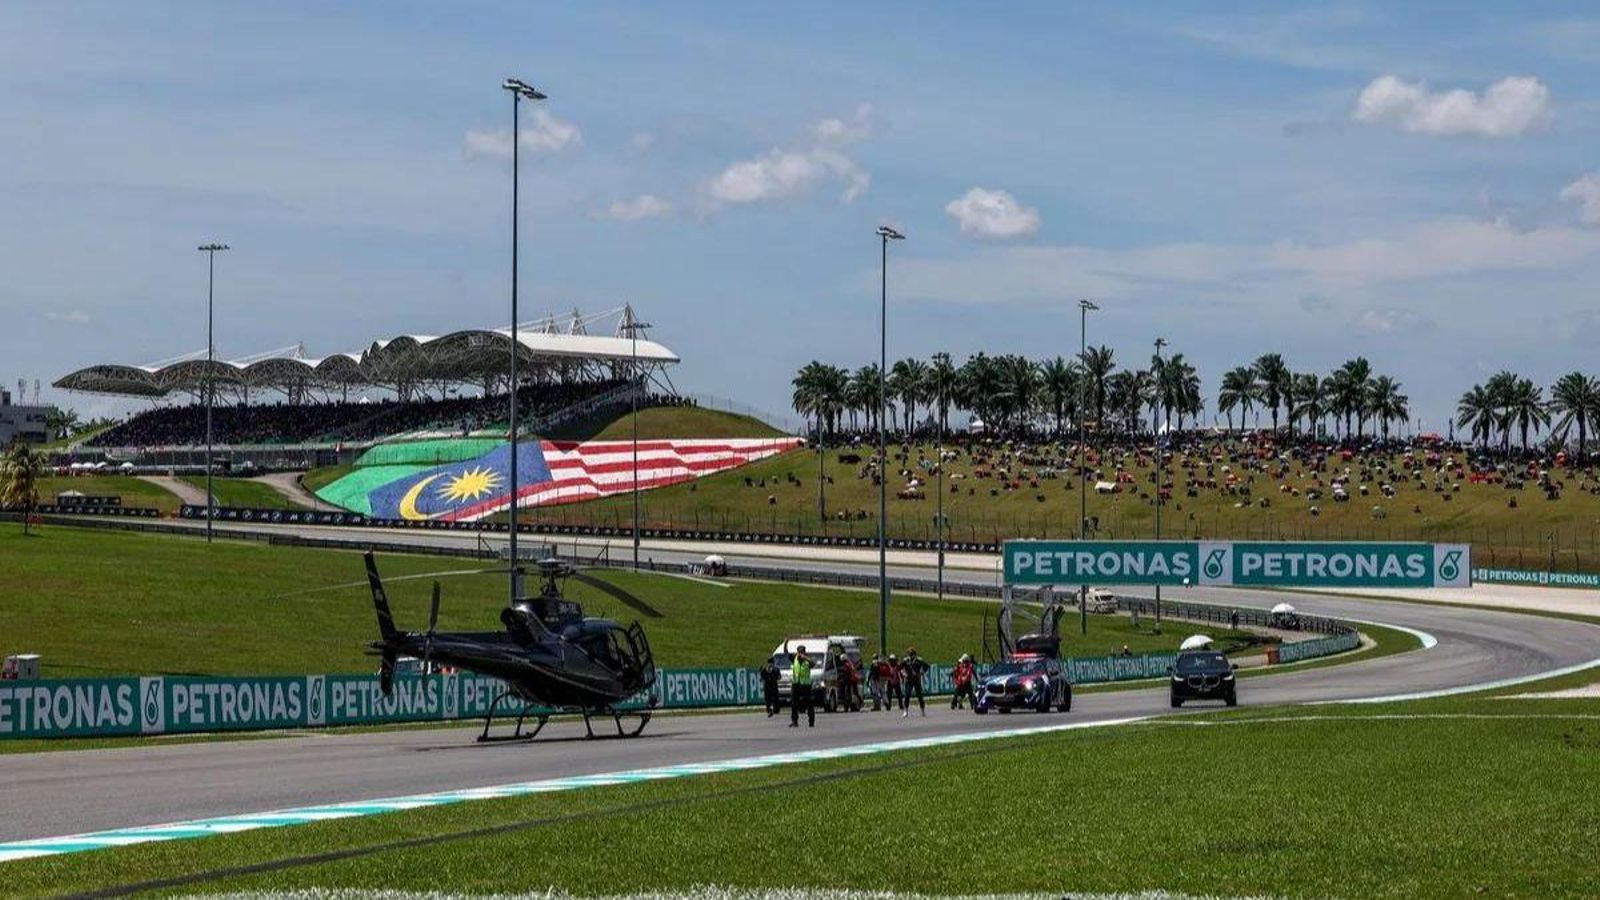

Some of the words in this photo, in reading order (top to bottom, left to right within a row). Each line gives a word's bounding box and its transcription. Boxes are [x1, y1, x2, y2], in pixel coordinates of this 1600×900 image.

[1013, 552, 1191, 576] PETRONAS
[1242, 553, 1426, 577] PETRONAS
[1489, 570, 1537, 581] PETRONAS
[1550, 573, 1598, 585] PETRONAS
[172, 682, 300, 724] PETRONAS
[667, 671, 734, 701] PETRONAS
